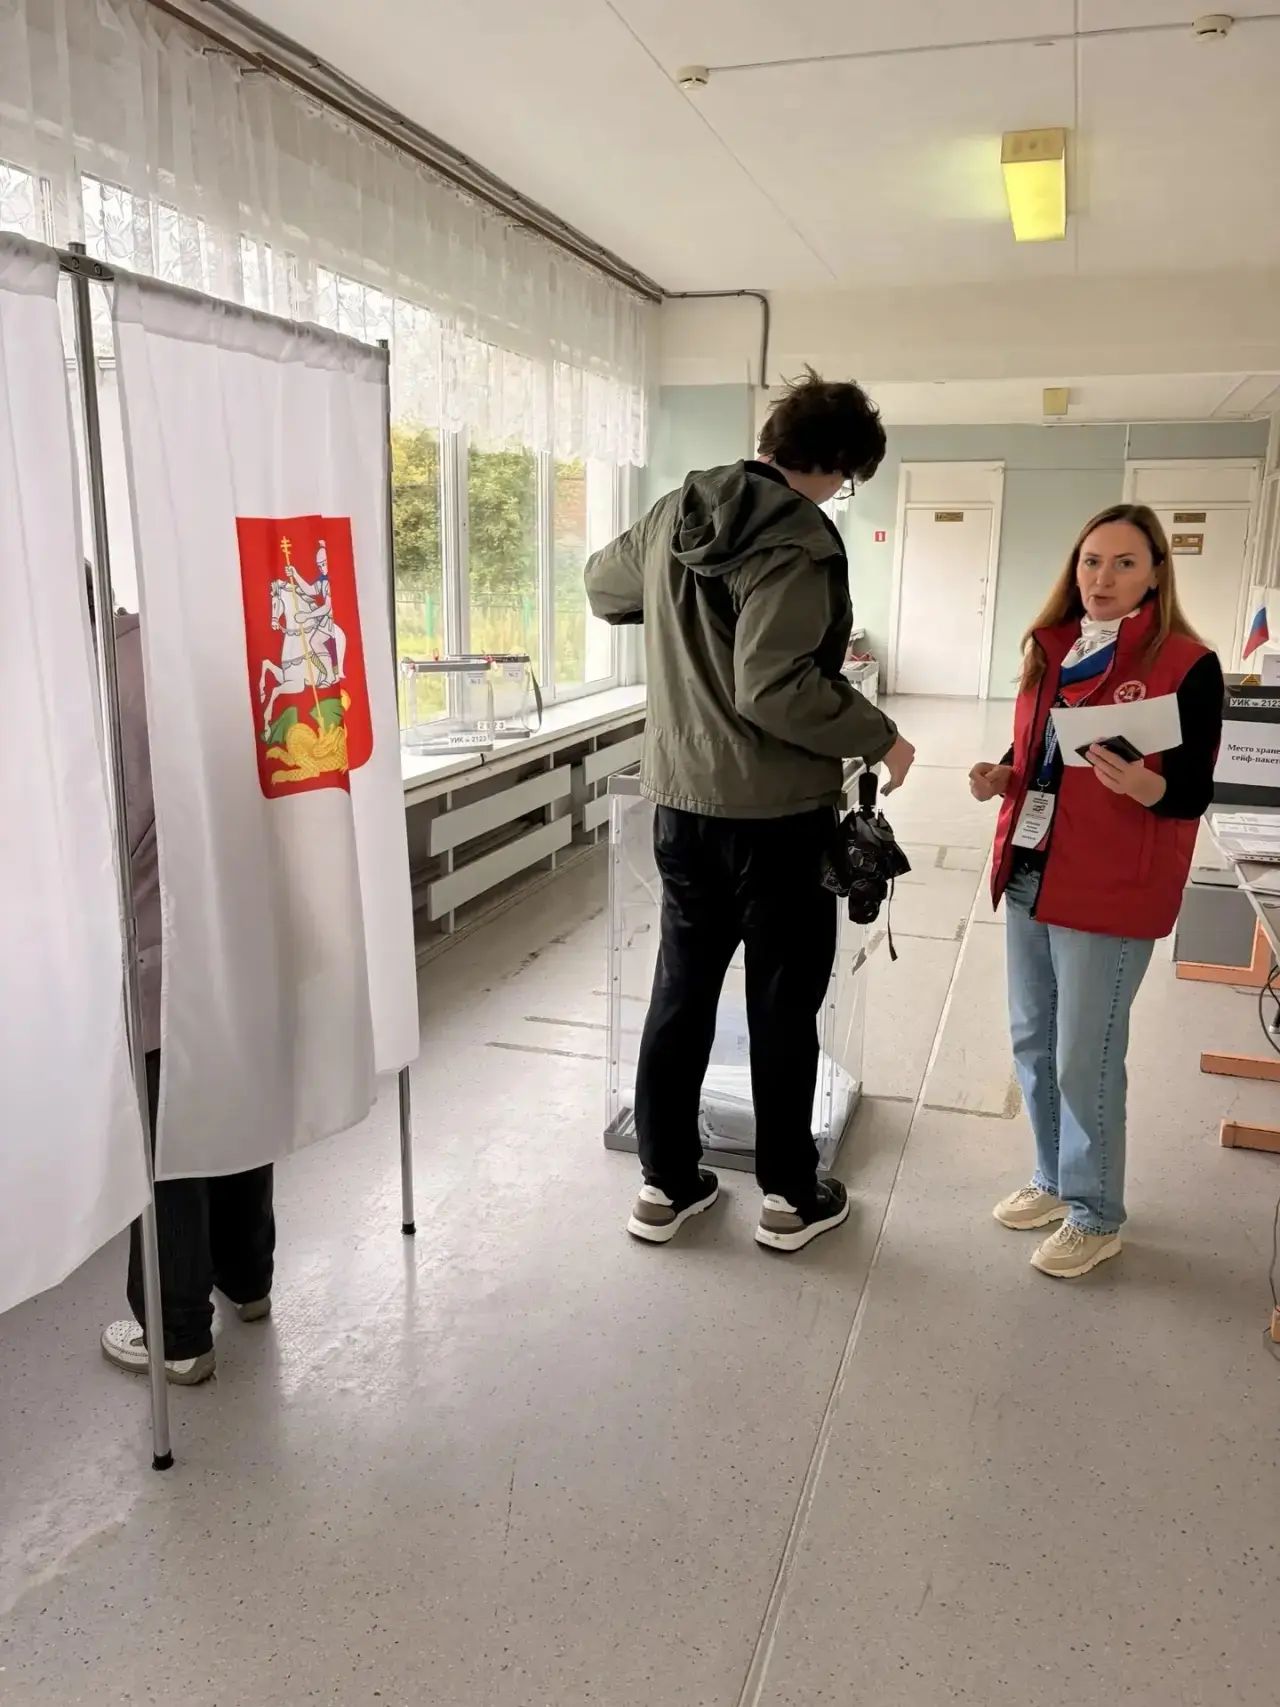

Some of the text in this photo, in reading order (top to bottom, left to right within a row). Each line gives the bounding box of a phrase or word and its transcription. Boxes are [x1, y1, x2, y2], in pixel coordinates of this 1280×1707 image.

[1231, 698, 1251, 706] УИК
[472, 735, 487, 743] 2123
[1227, 744, 1254, 752] Место
[1231, 755, 1280, 764] сейф-пакет
